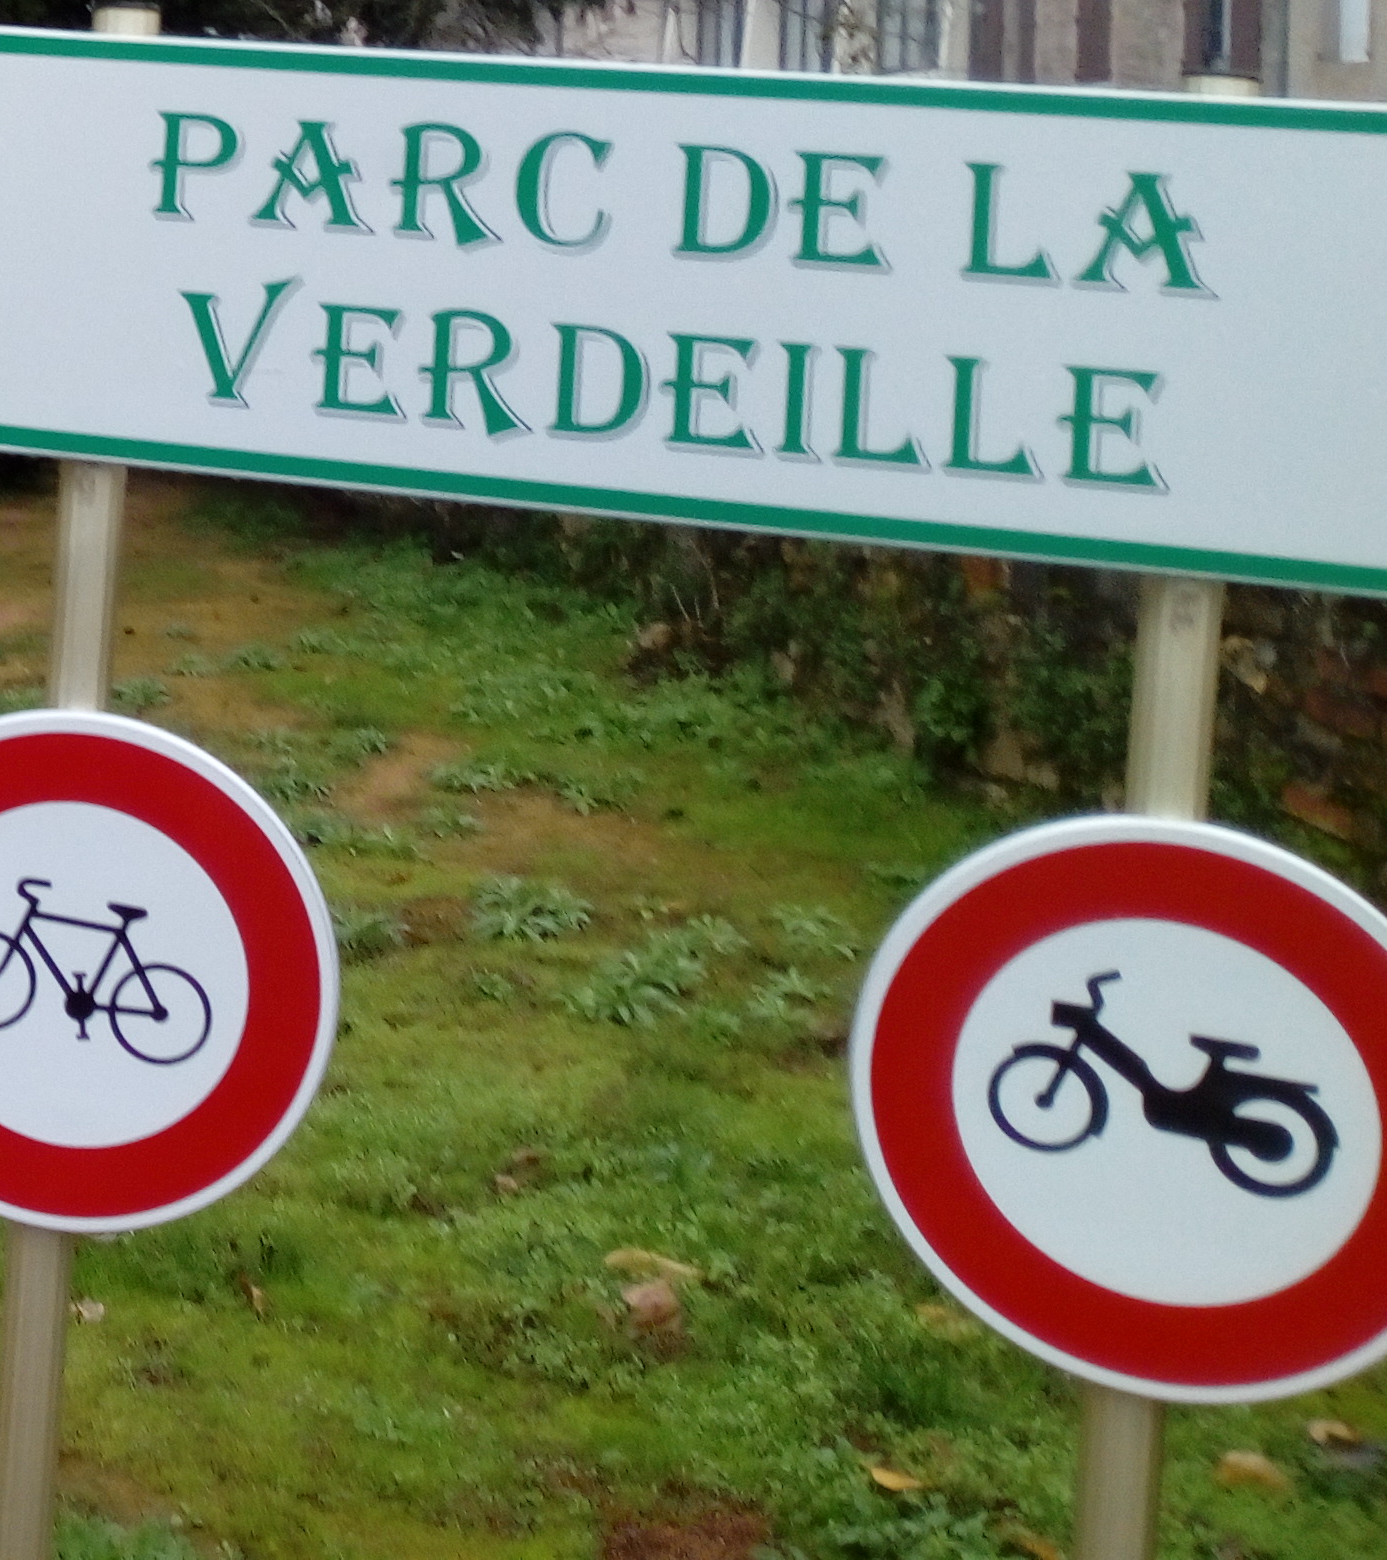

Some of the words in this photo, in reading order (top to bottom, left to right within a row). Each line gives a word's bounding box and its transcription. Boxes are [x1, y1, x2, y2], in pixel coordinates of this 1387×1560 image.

[151, 109, 613, 248] PARC
[674, 142, 888, 270] DE
[962, 160, 1207, 293] LA
[179, 278, 1163, 490] VERDEILLE
